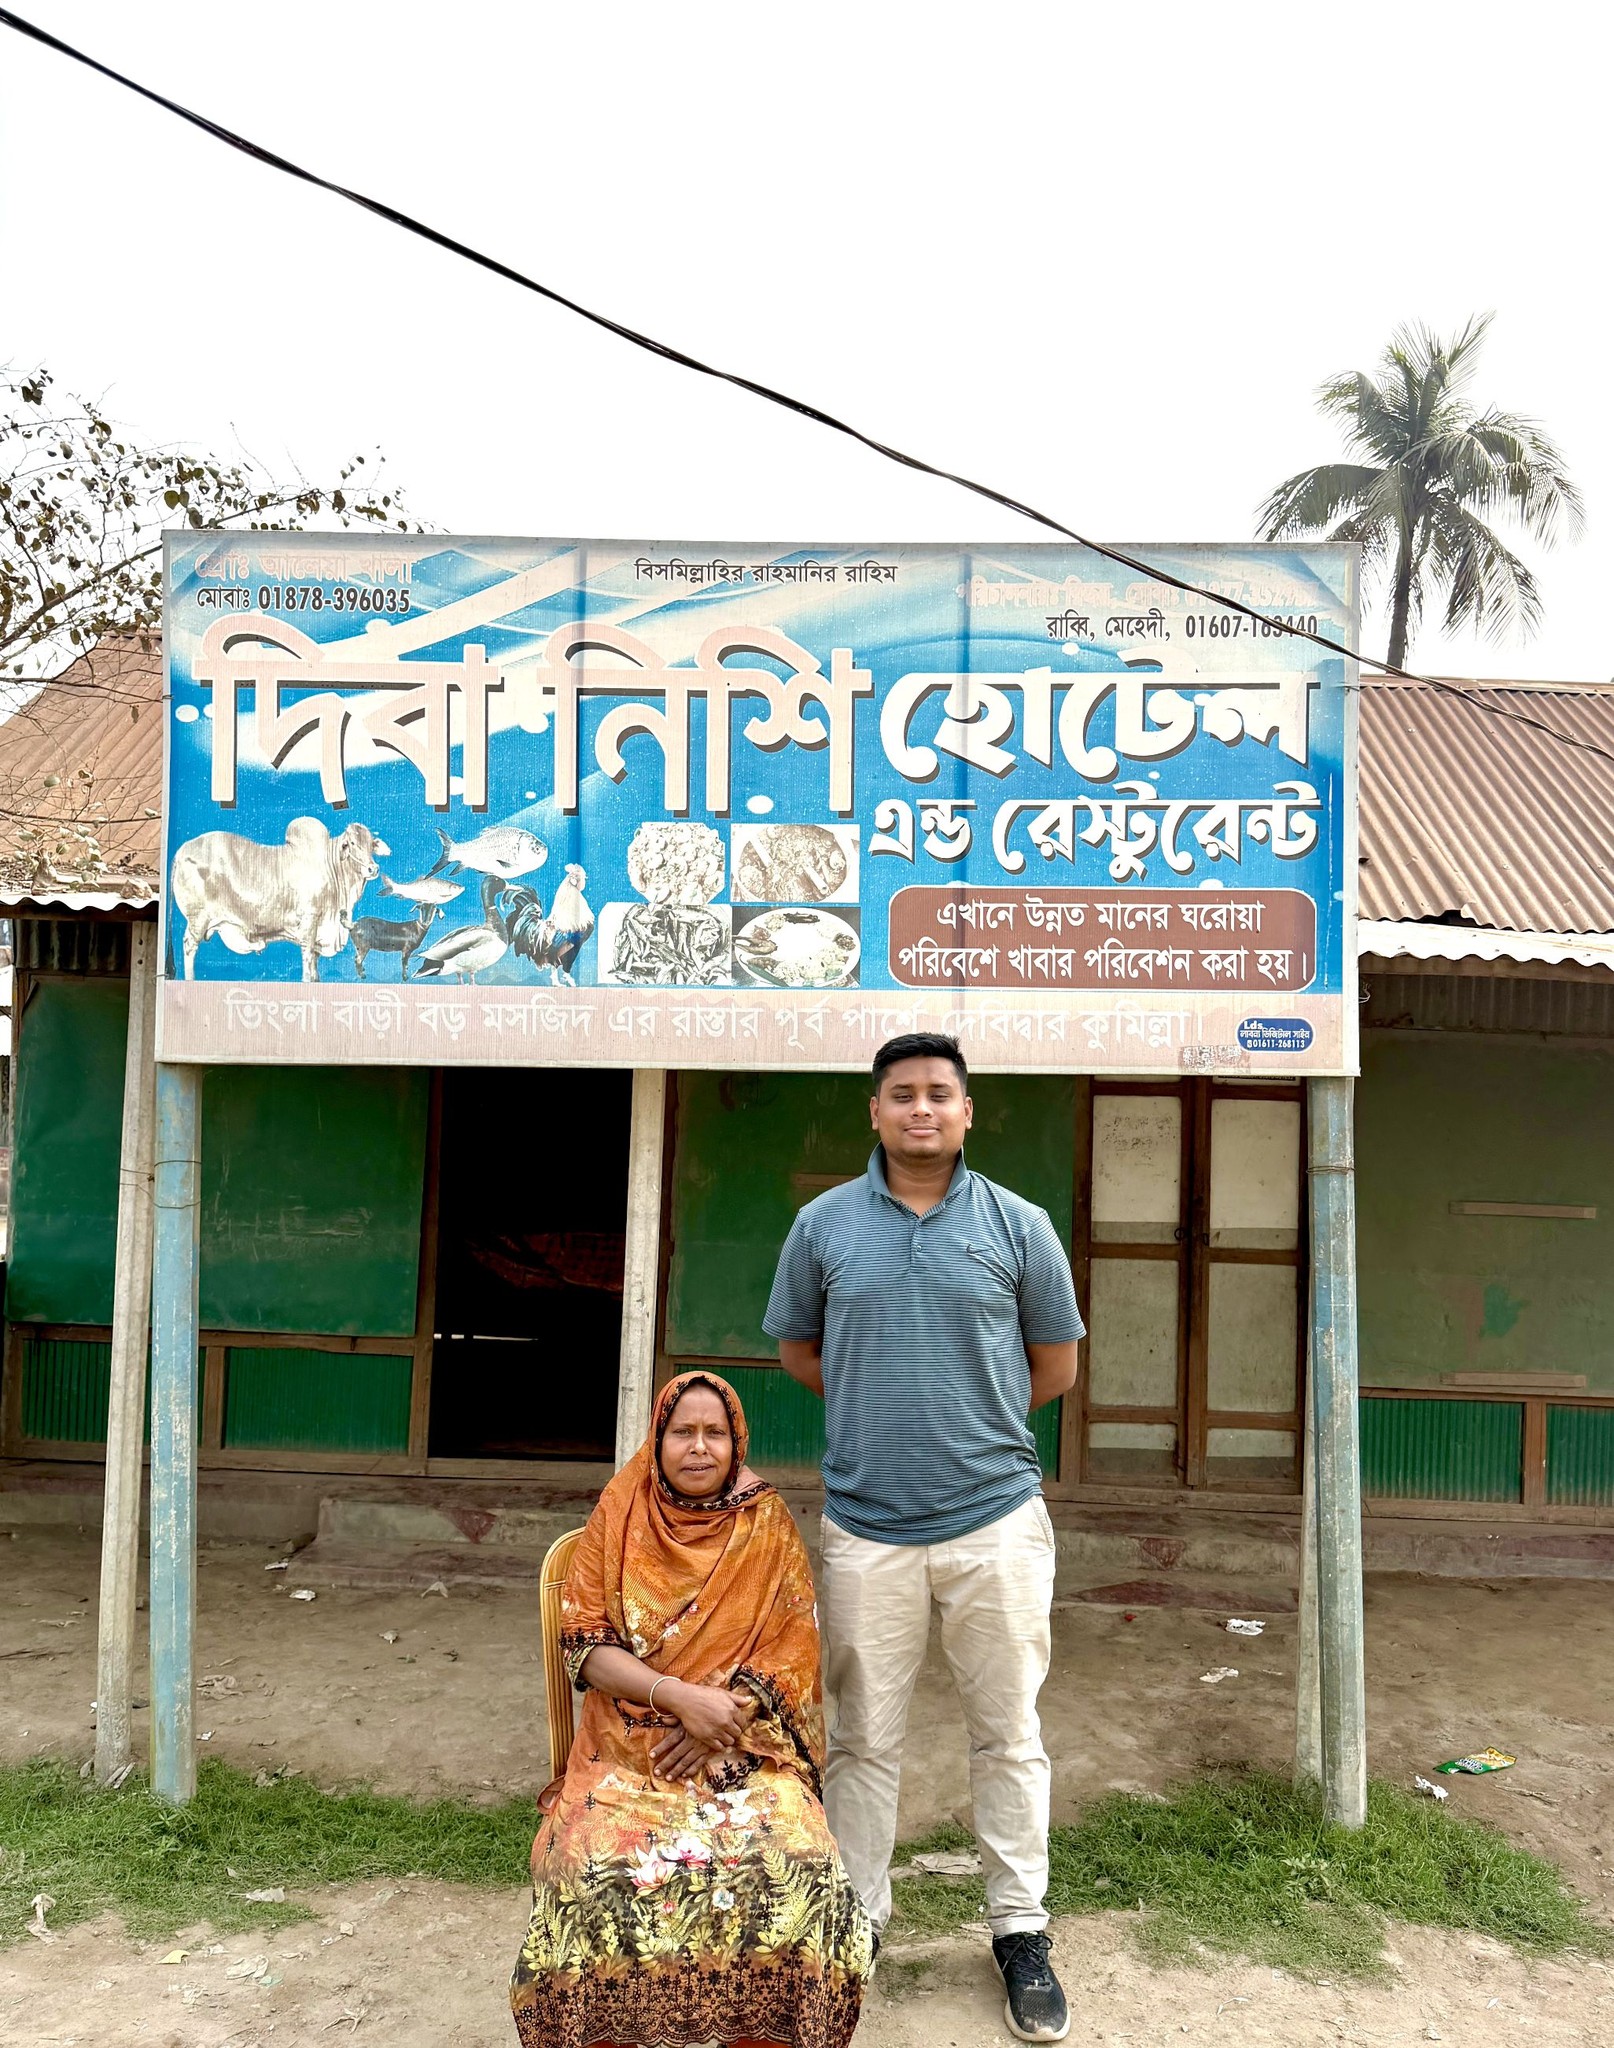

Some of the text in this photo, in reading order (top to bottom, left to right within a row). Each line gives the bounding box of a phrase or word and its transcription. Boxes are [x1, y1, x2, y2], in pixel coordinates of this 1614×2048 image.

[634, 557, 898, 584] বিসমিল্লাহির রাহমানির রাহিম
[197, 585, 411, 613] মোবাঃ 01878-396035
[1046, 609, 1095, 641] রাব্বি,
[1104, 608, 1171, 641] মেহেদী,
[192, 614, 1322, 818] দিবা নিশি হোটেল
[869, 780, 1323, 882] এন্ড রেস্টুরেন্ট
[936, 893, 1266, 937] এখানে উন্নত মানের ঘরোয়া
[898, 936, 1001, 980] পরিবেশে
[1007, 945, 1077, 979] খাবার
[1083, 937, 1194, 982] পরিবেশন
[1199, 945, 1249, 982] করা
[223, 987, 323, 1035] ভিংলা
[331, 988, 407, 1040] বাড়ী
[415, 1000, 471, 1041] বড়
[480, 991, 598, 1038] মসজিদ
[607, 1004, 661, 1038] এর
[668, 1002, 764, 1041] রাস্তার
[774, 994, 832, 1051] পূর্ব
[940, 999, 1071, 1043] দেবিদ্বার
